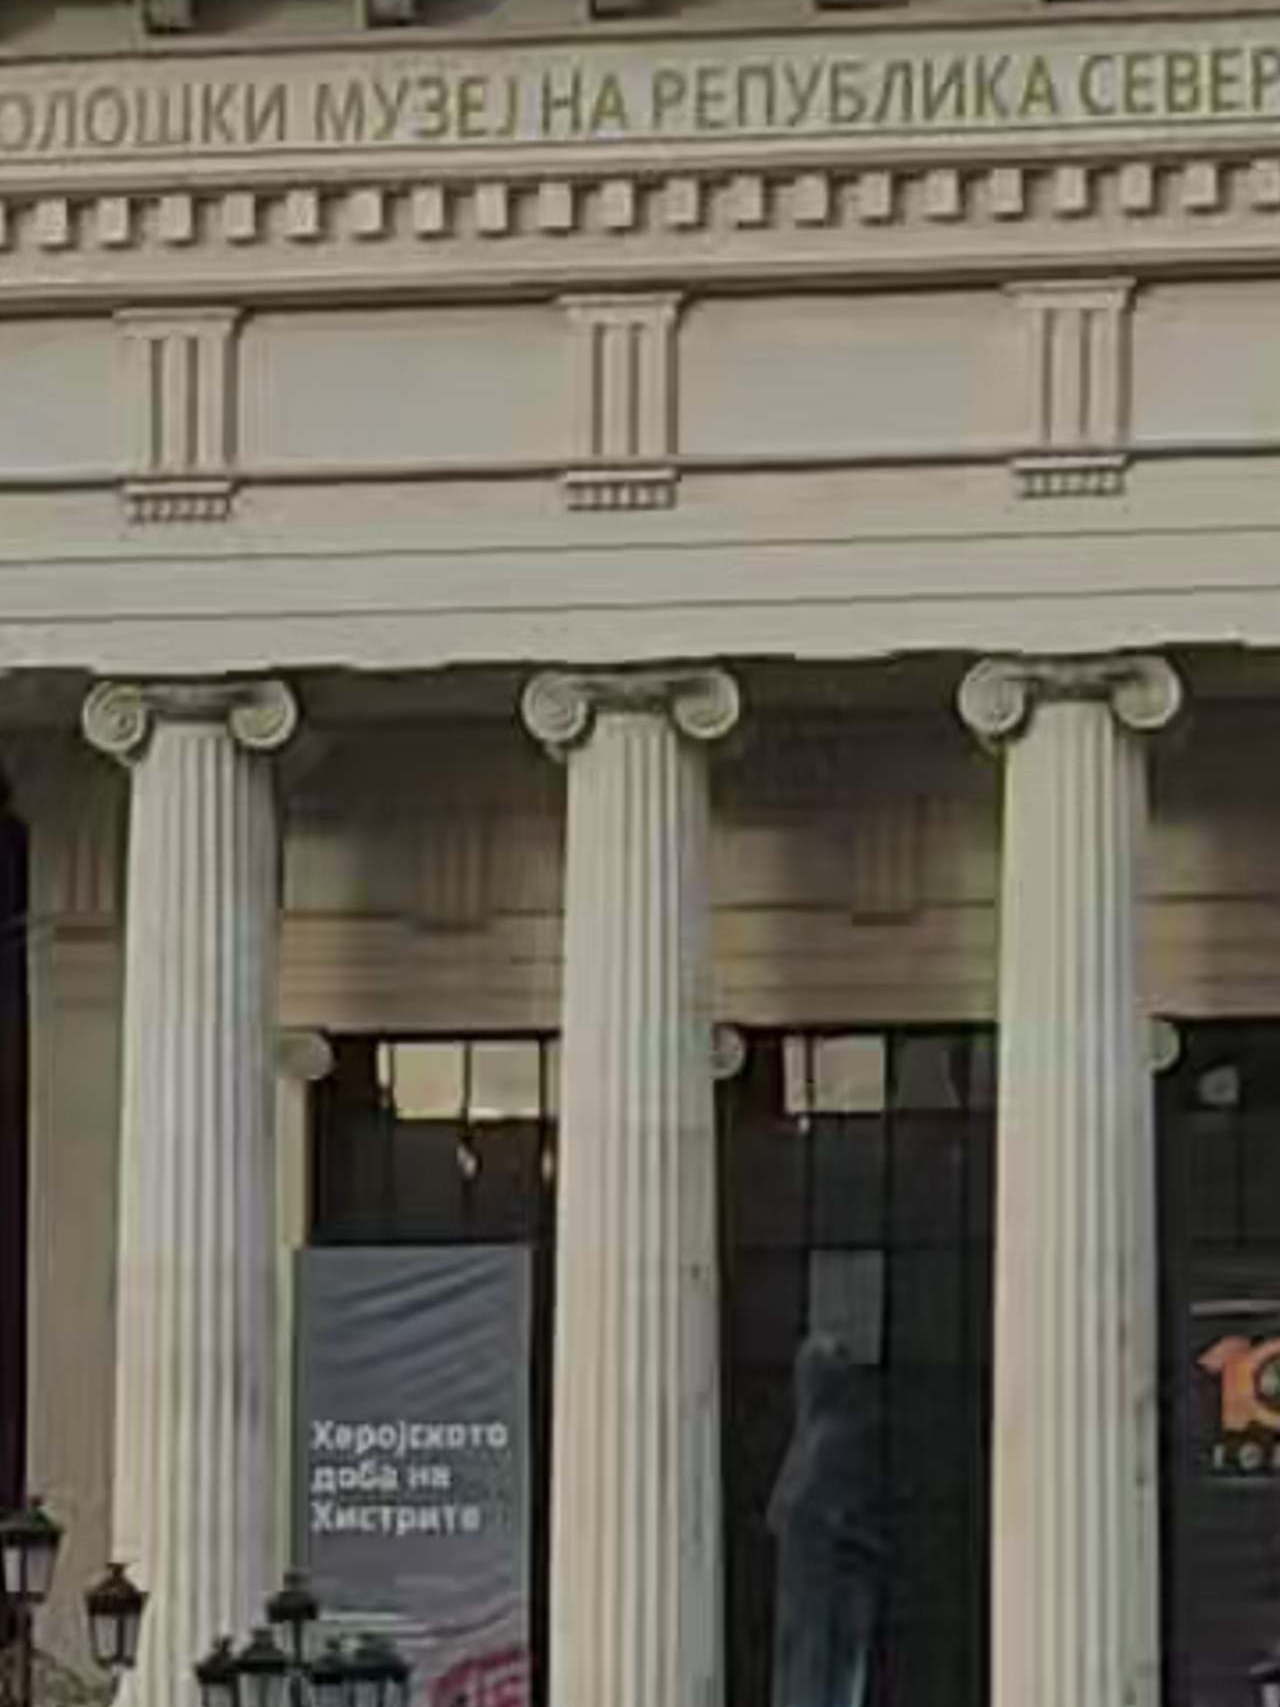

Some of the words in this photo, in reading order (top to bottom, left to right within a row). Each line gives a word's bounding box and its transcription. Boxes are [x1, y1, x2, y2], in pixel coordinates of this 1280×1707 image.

[314, 71, 521, 143] МУЗЕЈ
[540, 67, 631, 133] НА
[650, 53, 1061, 130] РЕПУБЛИКА
[311, 1419, 508, 1458] Херојското
[311, 1461, 399, 1495] доба
[408, 1464, 452, 1489] на
[311, 1501, 482, 1535] Хистрите
